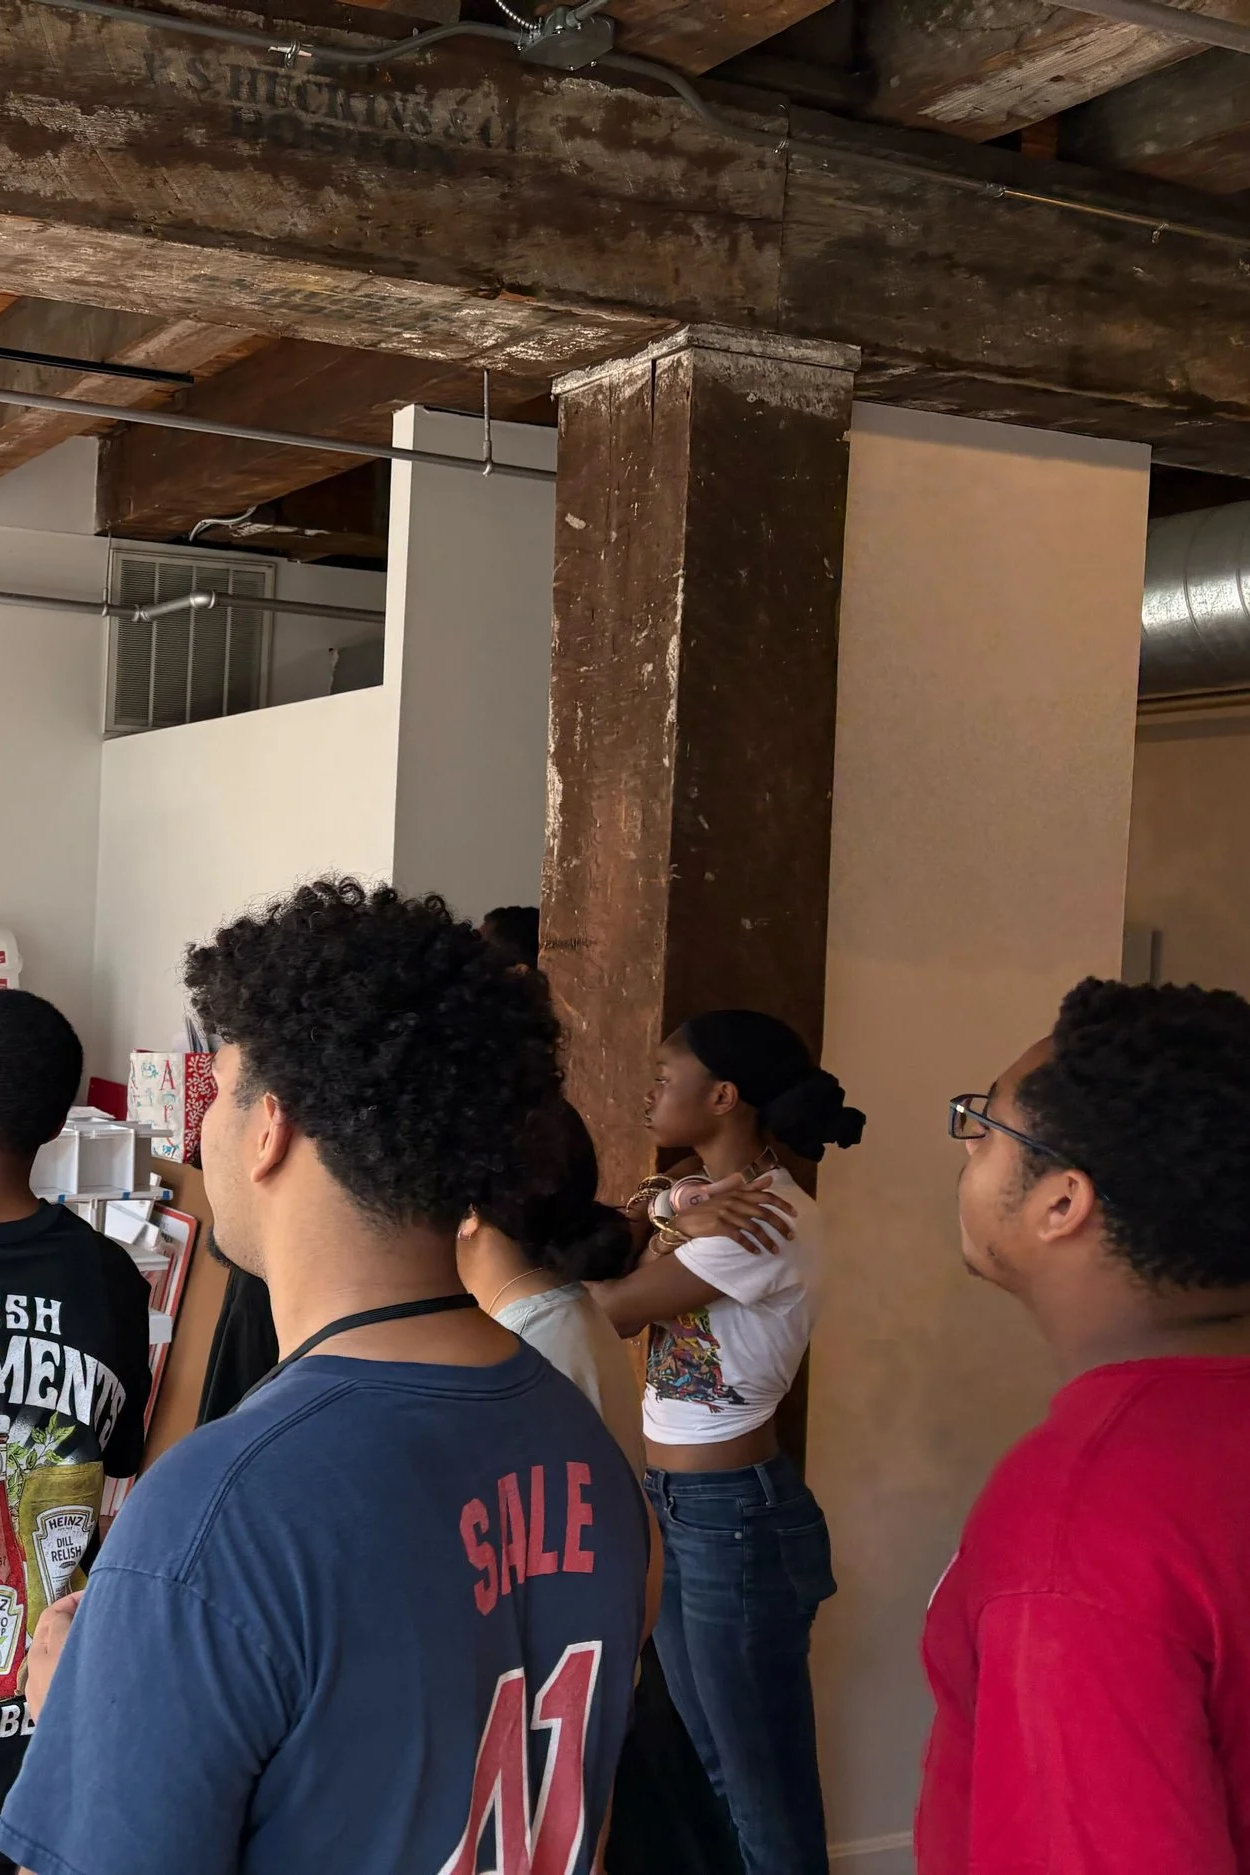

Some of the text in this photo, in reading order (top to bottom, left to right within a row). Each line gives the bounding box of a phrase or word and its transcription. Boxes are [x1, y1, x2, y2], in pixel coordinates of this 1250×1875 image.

[48, 1516, 84, 1530] HEINZ
[56, 1536, 74, 1549] DILL
[459, 1461, 595, 1617] SALE
[51, 1545, 83, 1562] RELISH
